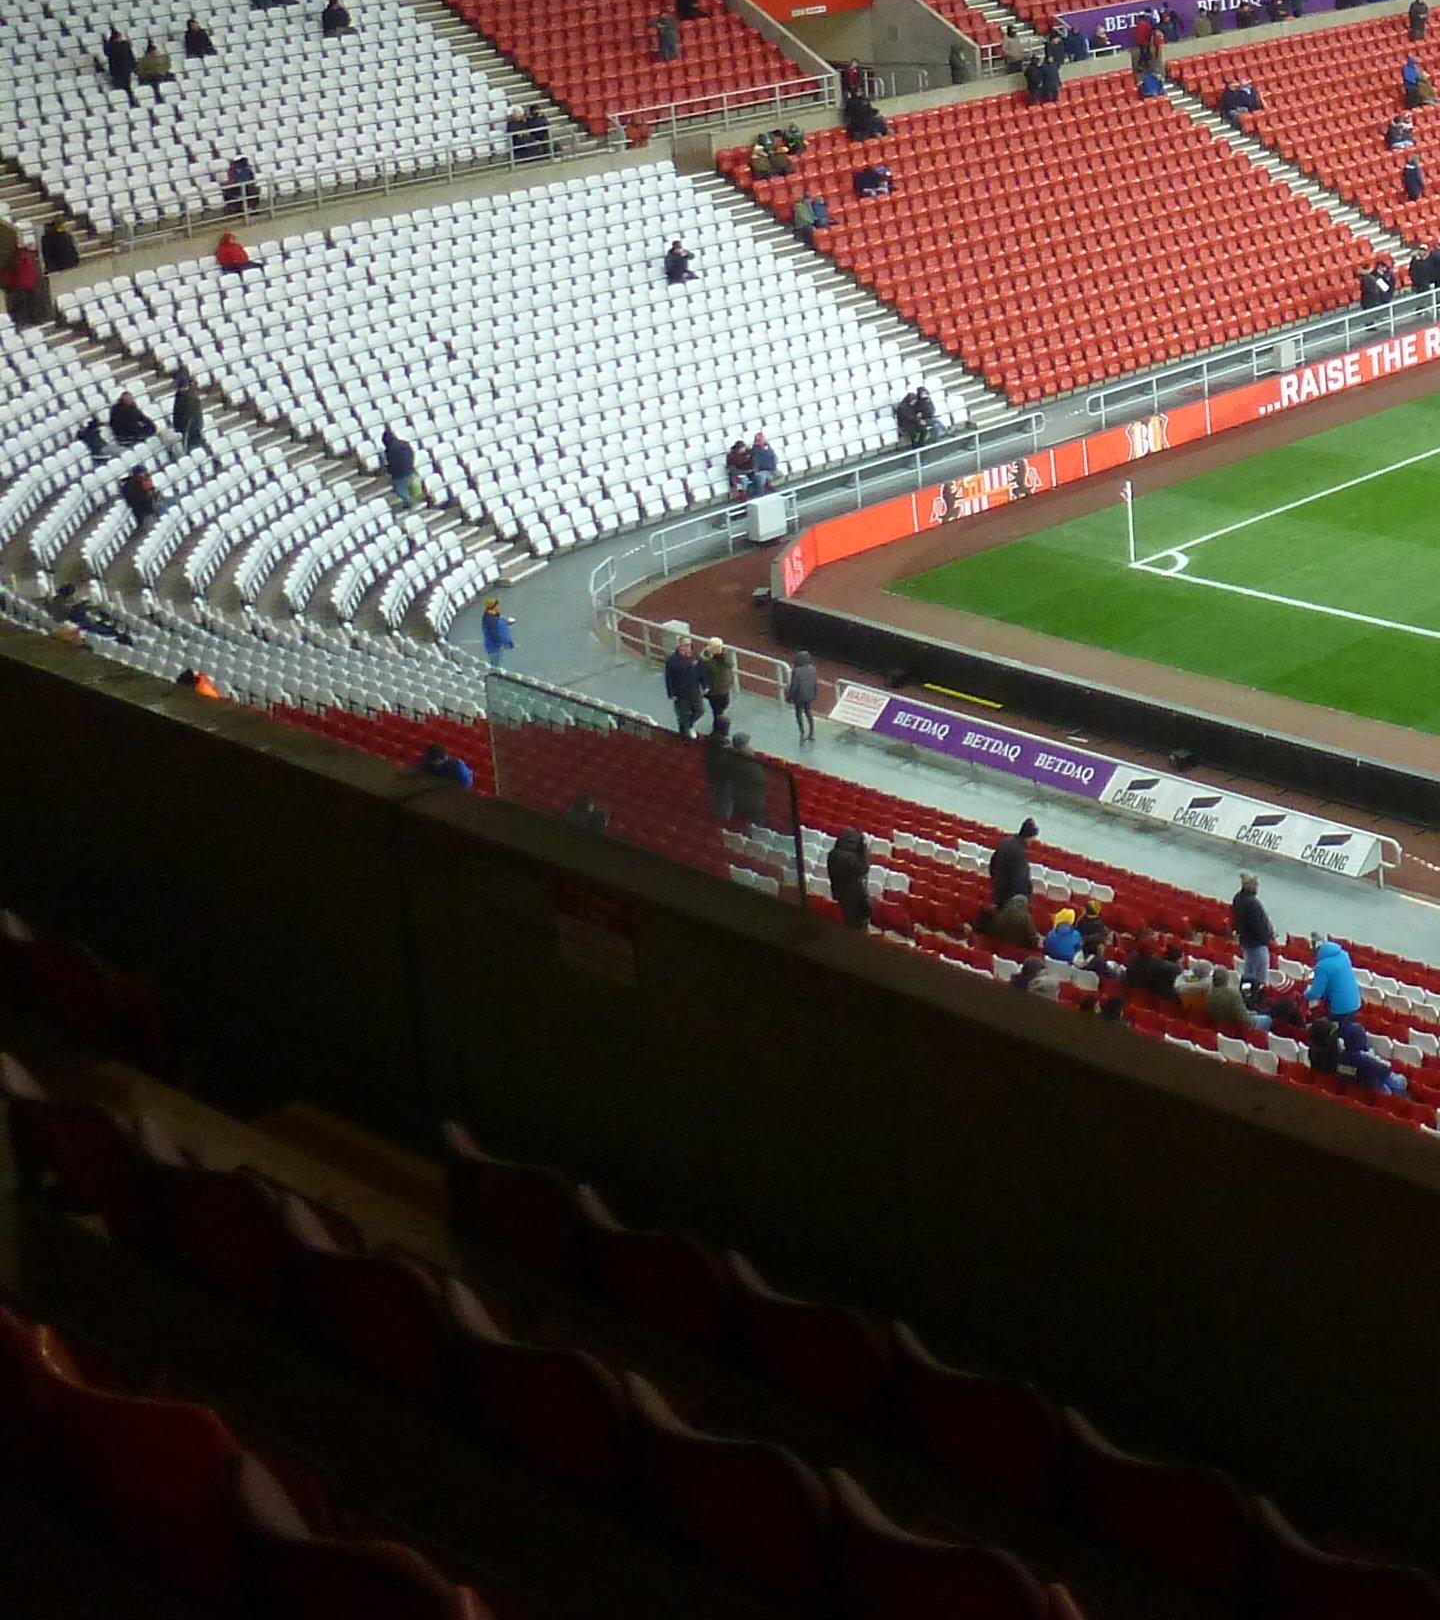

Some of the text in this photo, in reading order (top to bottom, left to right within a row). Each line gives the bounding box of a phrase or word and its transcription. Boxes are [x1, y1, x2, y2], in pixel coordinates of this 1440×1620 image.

[1366, 334, 1419, 378] THE
[893, 711, 950, 741] BETDAQ
[962, 732, 1021, 762] BETDAQ
[1034, 753, 1095, 785] BETDAQ
[1112, 789, 1156, 814] CARLING
[1173, 807, 1219, 832] CARLING
[1236, 825, 1283, 850] CARLING
[1300, 844, 1349, 871] CARLING
